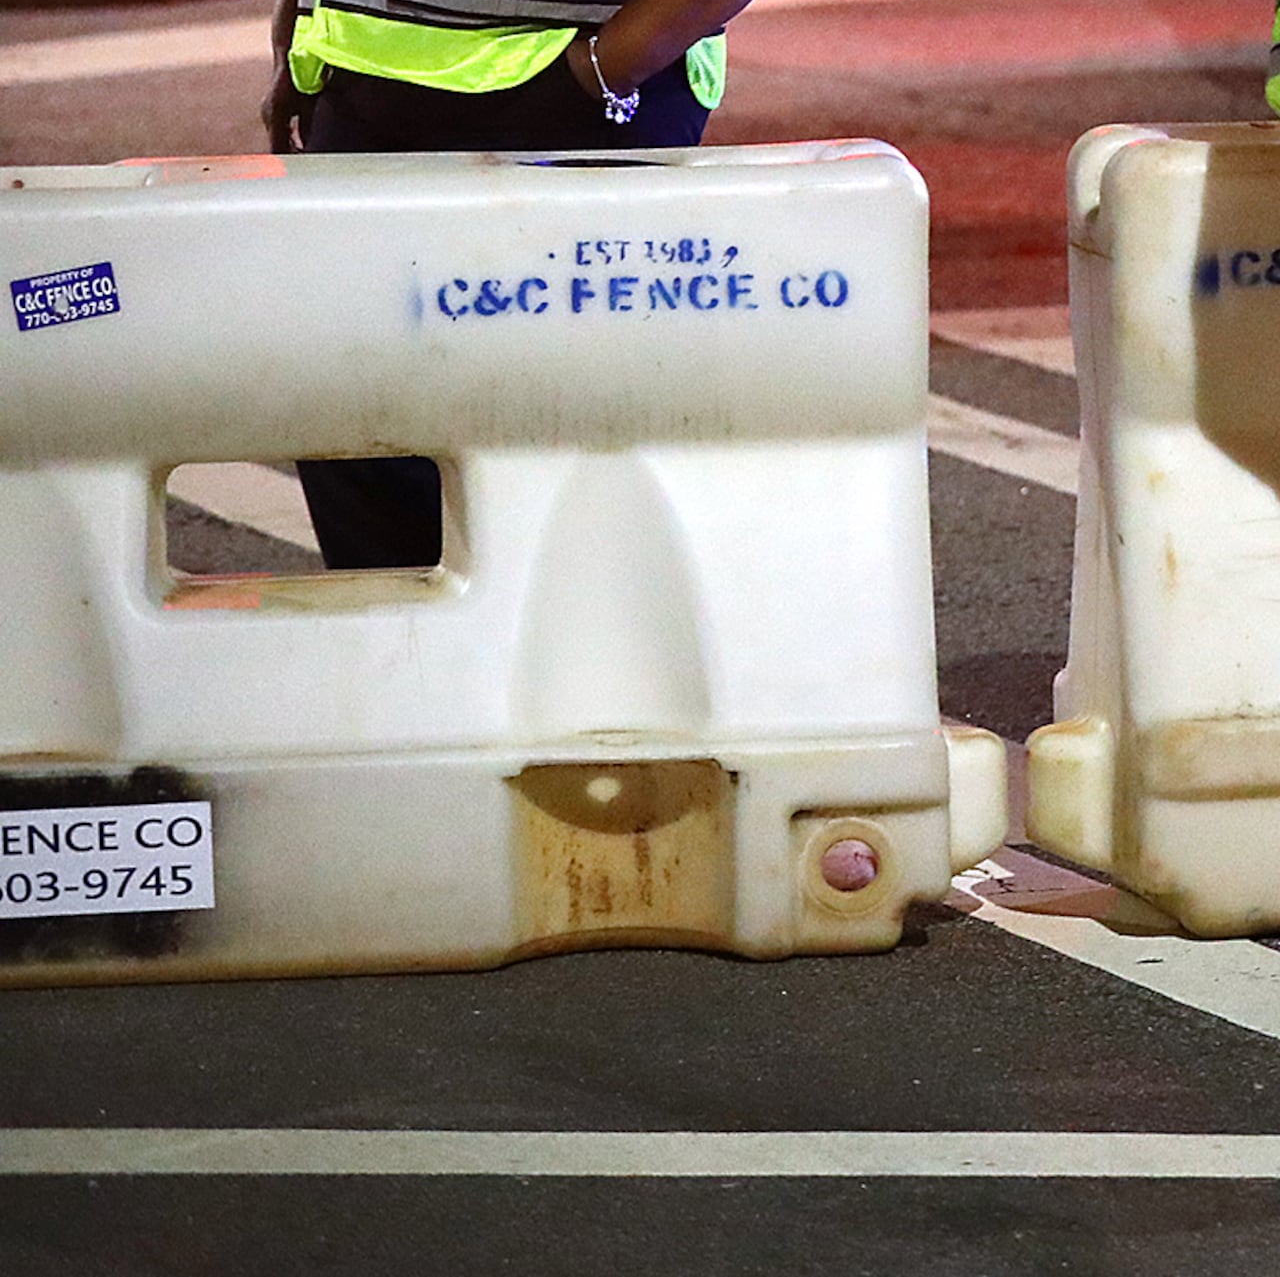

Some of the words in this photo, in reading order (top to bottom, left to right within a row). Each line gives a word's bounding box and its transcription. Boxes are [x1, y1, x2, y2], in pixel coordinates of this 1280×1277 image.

[576, 239, 631, 266] EST
[15, 290, 46, 313] C&C
[92, 276, 117, 297] CO.
[29, 270, 80, 289] PROPERTY
[80, 267, 94, 278] OF
[437, 278, 549, 317] C&C
[571, 273, 758, 314] FENCE
[780, 269, 850, 308] CO
[2, 820, 120, 856] ENCE
[134, 816, 203, 849] CO
